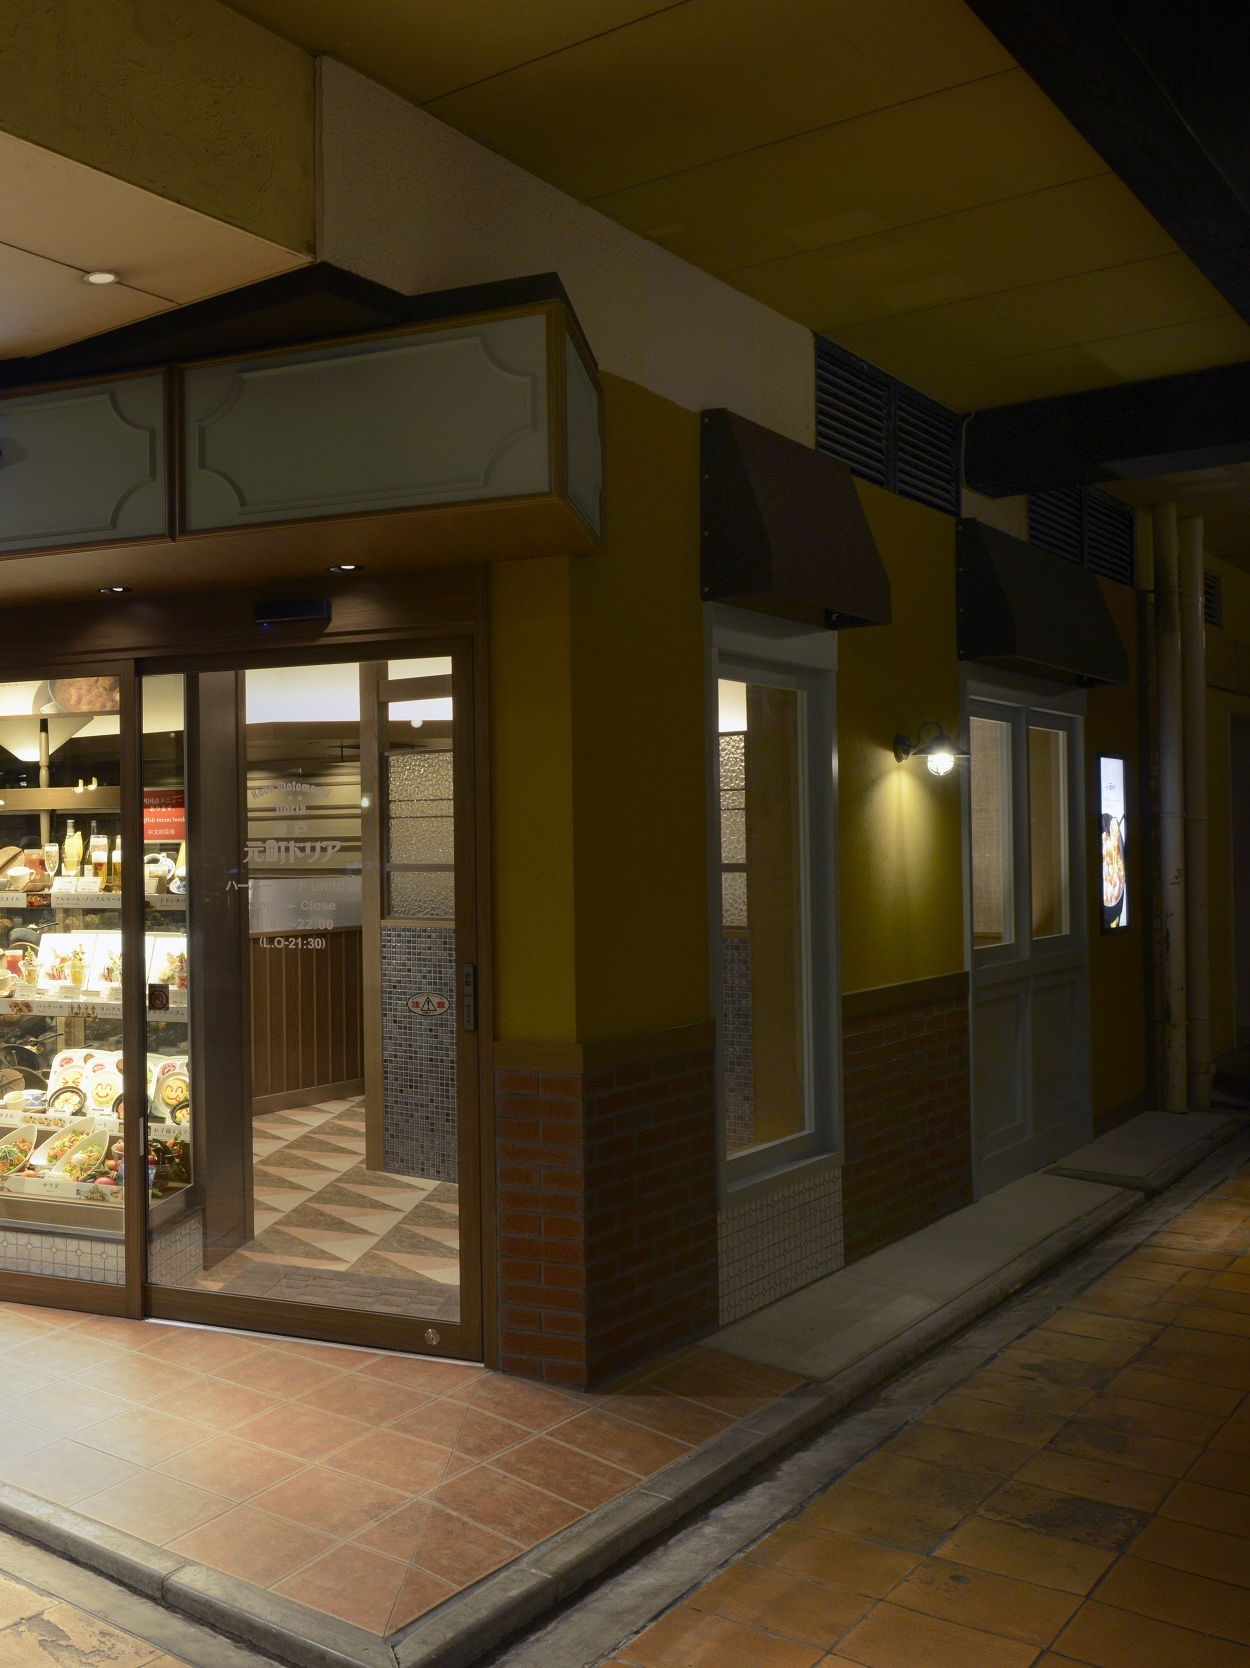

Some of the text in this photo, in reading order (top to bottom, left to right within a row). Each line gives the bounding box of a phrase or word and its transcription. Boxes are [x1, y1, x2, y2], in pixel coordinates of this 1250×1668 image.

[143, 817, 156, 825] glish
[271, 821, 309, 836] 神戸
[243, 839, 342, 864] 元町ドリア
[300, 900, 337, 911] Close
[259, 937, 326, 949] (L.O-21:30)
[42, 1181, 60, 1189] サラダ
